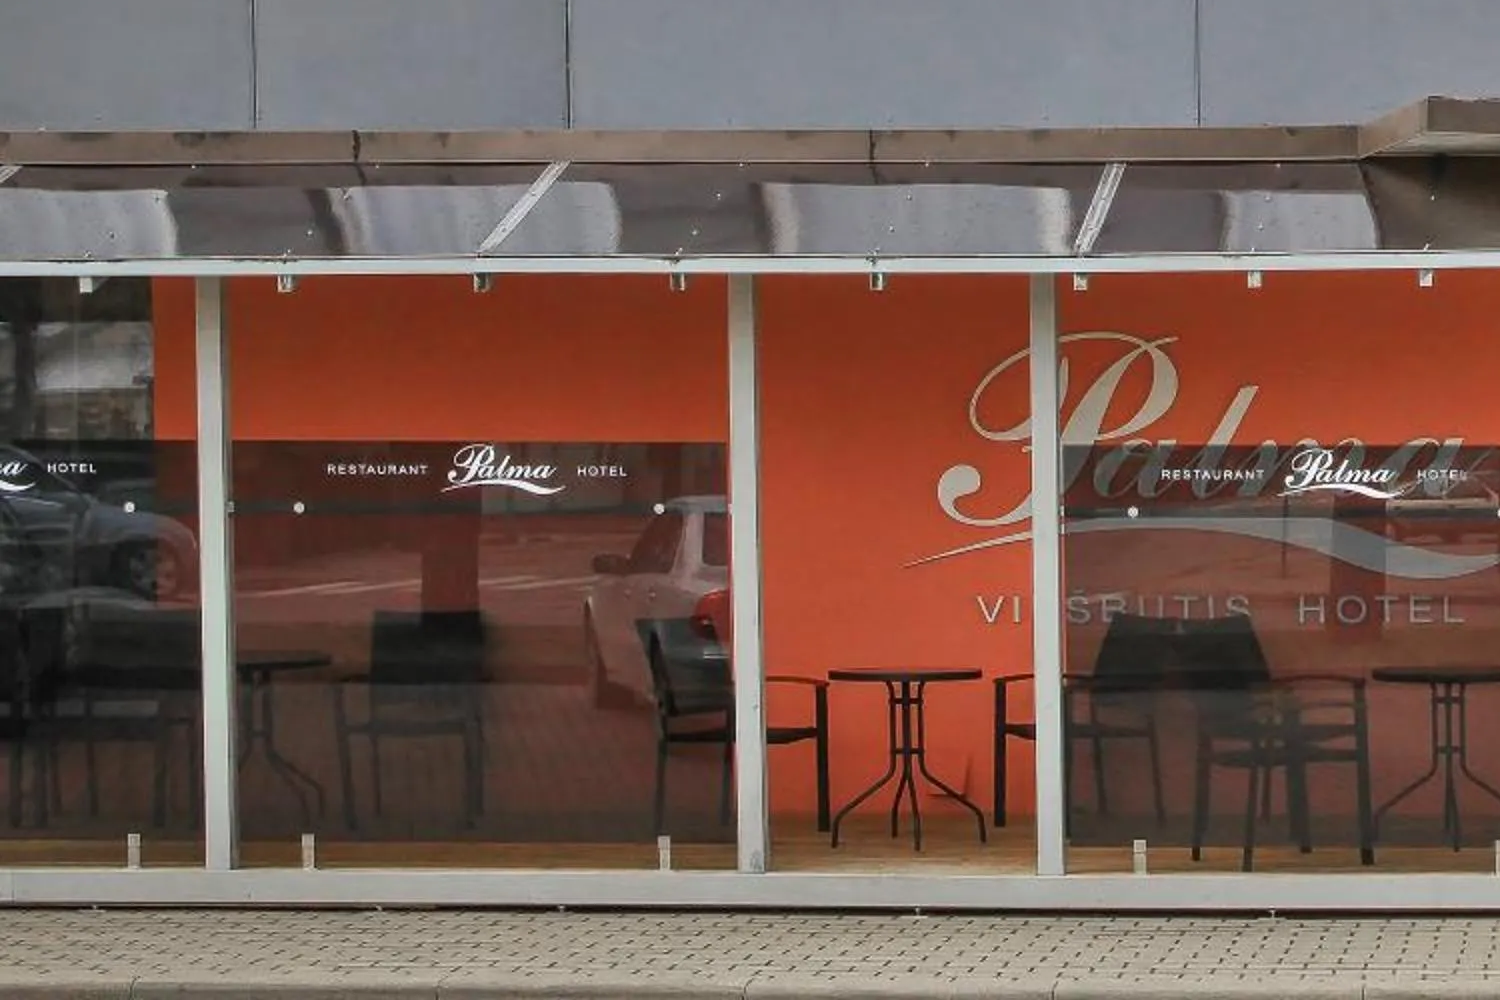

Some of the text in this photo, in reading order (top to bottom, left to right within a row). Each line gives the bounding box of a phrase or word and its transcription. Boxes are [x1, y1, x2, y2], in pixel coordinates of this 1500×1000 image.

[46, 463, 98, 475] HOTEL
[326, 444, 628, 483] RESTAURANT Palma HOTEL
[1161, 450, 1468, 489] RESTAURANT Palma HOTEL
[976, 590, 1466, 624] VIŠBUTIS HOTEL
